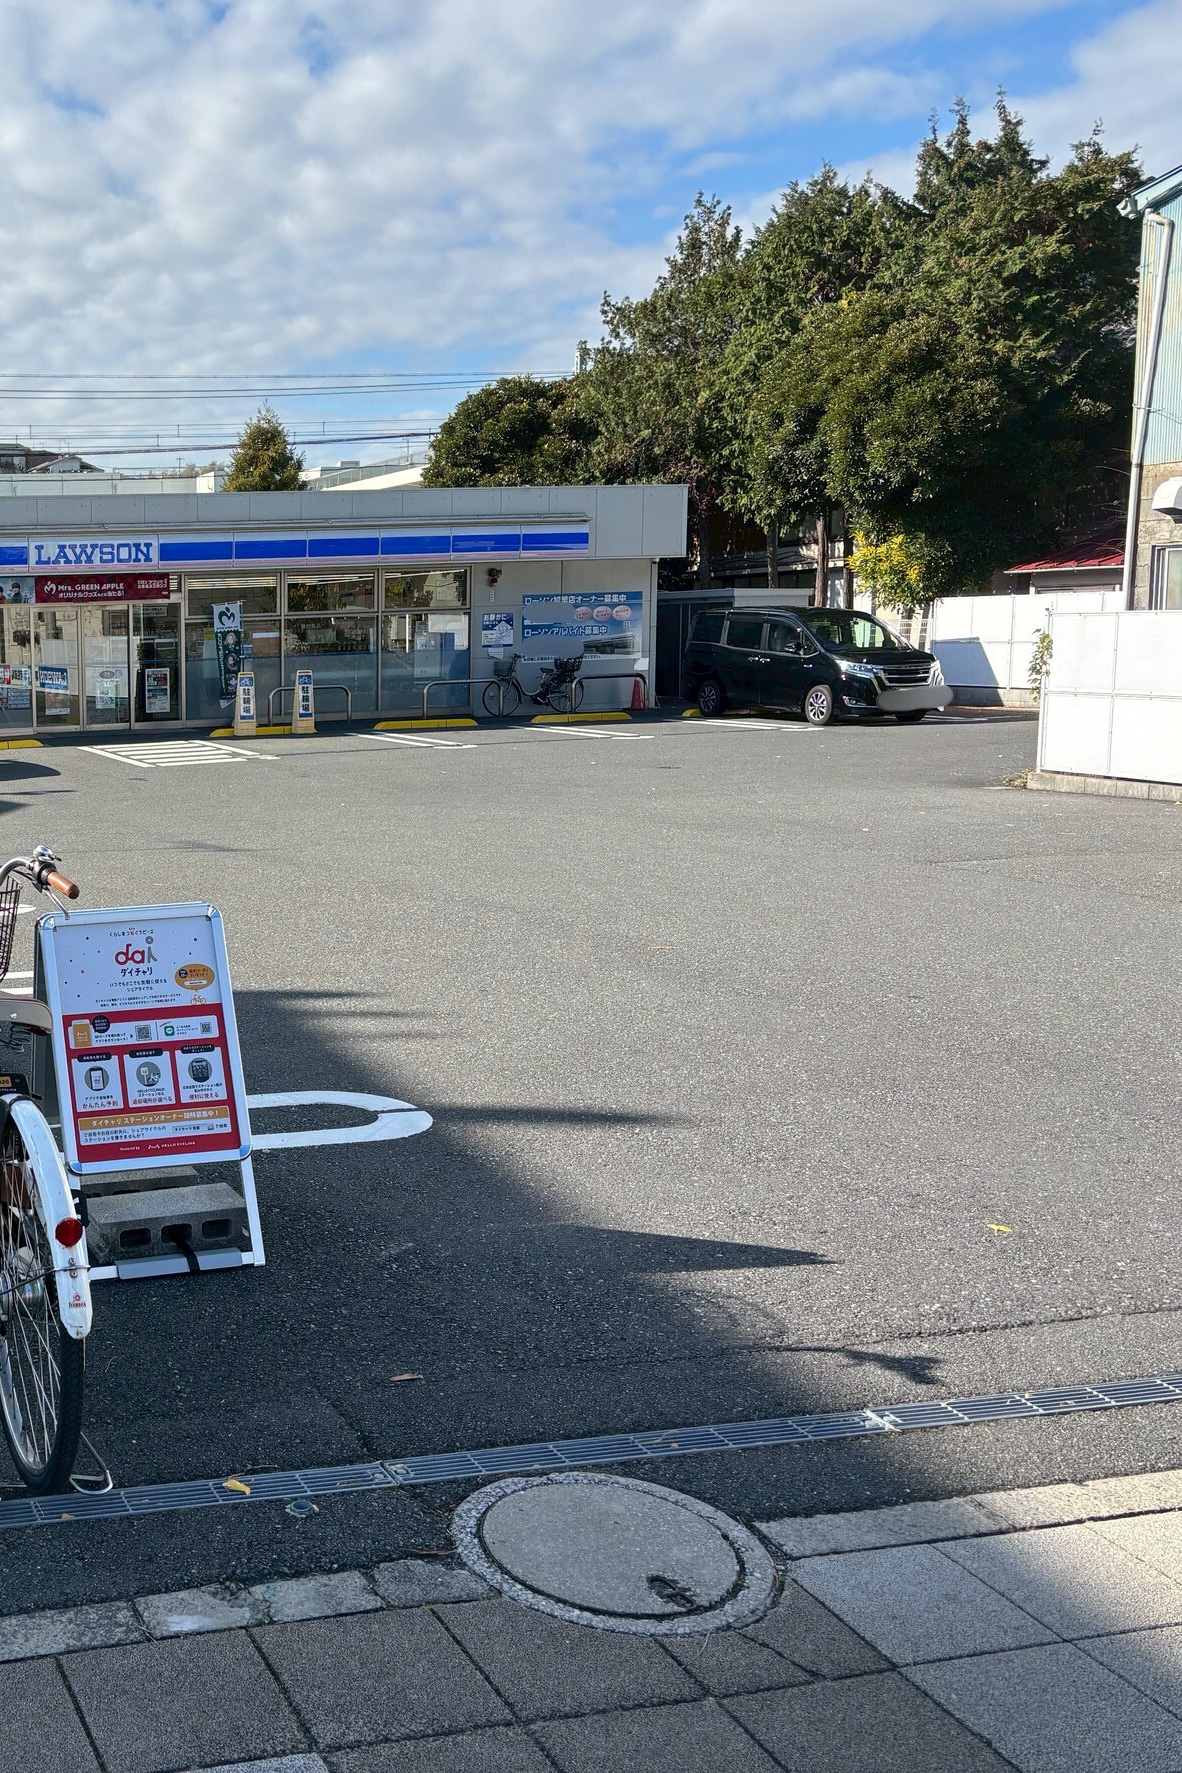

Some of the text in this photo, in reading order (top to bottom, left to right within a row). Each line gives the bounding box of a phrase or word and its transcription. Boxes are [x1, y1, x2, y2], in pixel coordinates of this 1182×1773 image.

[35, 542, 153, 565] LAWSON
[75, 583, 100, 591] GREEN
[525, 625, 607, 637] ローソンアルバイト募集中
[242, 687, 251, 714] 駐輪場
[301, 685, 310, 712] 駐輪場
[120, 966, 153, 977] ダイチャリ
[82, 1100, 118, 1109] かんたん予約
[91, 1118, 121, 1127] ダイチャリ
